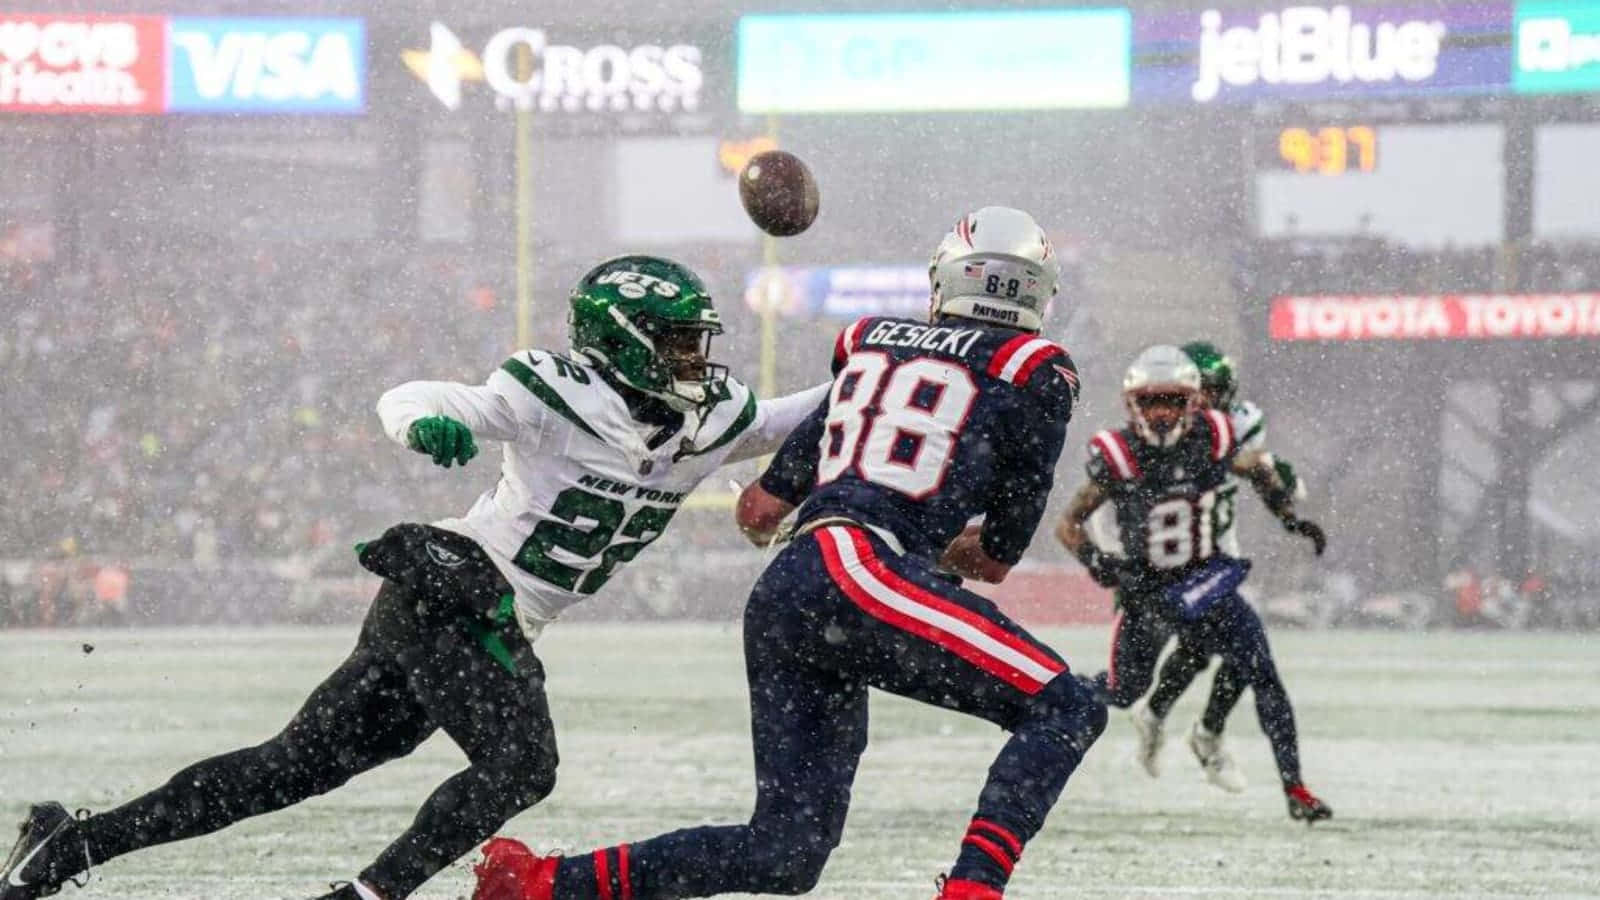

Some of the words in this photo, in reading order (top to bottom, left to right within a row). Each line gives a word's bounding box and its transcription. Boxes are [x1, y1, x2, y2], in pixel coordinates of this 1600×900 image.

[172, 30, 361, 101] VISA
[1191, 5, 1442, 101] jetBlue
[597, 270, 681, 298] JETS
[971, 302, 1020, 323] PATRIOTS
[865, 319, 983, 357] GESICKI
[1292, 297, 1449, 338] TOYOTA
[1465, 295, 1600, 337] TOYOT
[817, 352, 981, 500] 88
[577, 474, 632, 496] NEW
[634, 486, 688, 504] YORK
[511, 486, 677, 594] 22
[1147, 490, 1217, 569] 81
